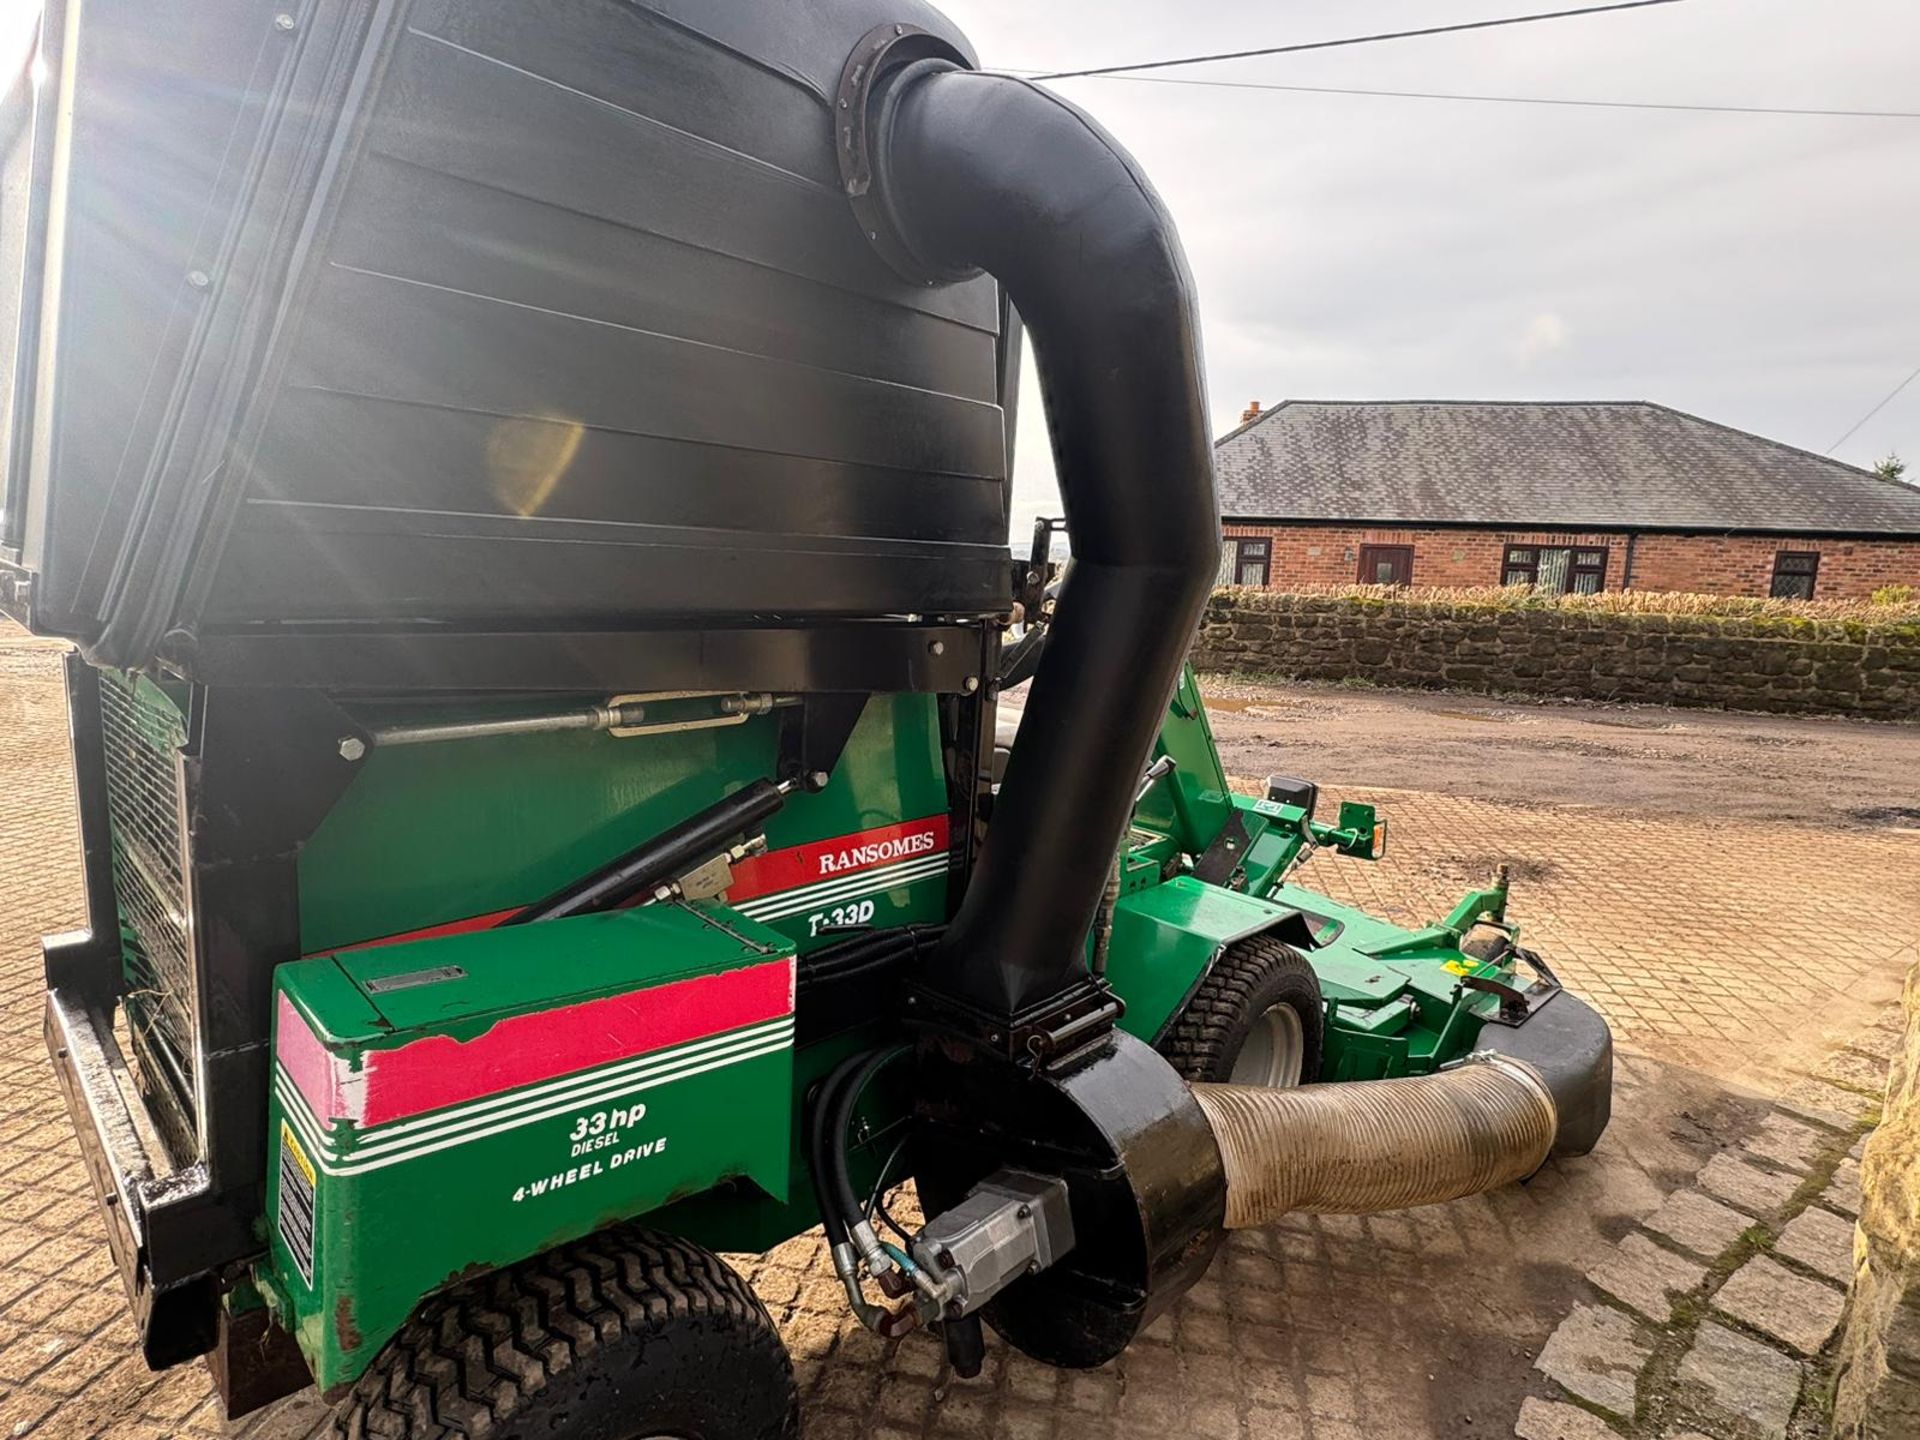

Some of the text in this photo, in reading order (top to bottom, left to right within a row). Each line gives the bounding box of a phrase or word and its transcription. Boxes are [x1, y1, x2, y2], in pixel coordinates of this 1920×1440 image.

[819, 832, 934, 874] RANSOMES
[570, 1131, 620, 1158] DIESEL
[512, 1137, 667, 1202] 4-WHEEL DRIVE
